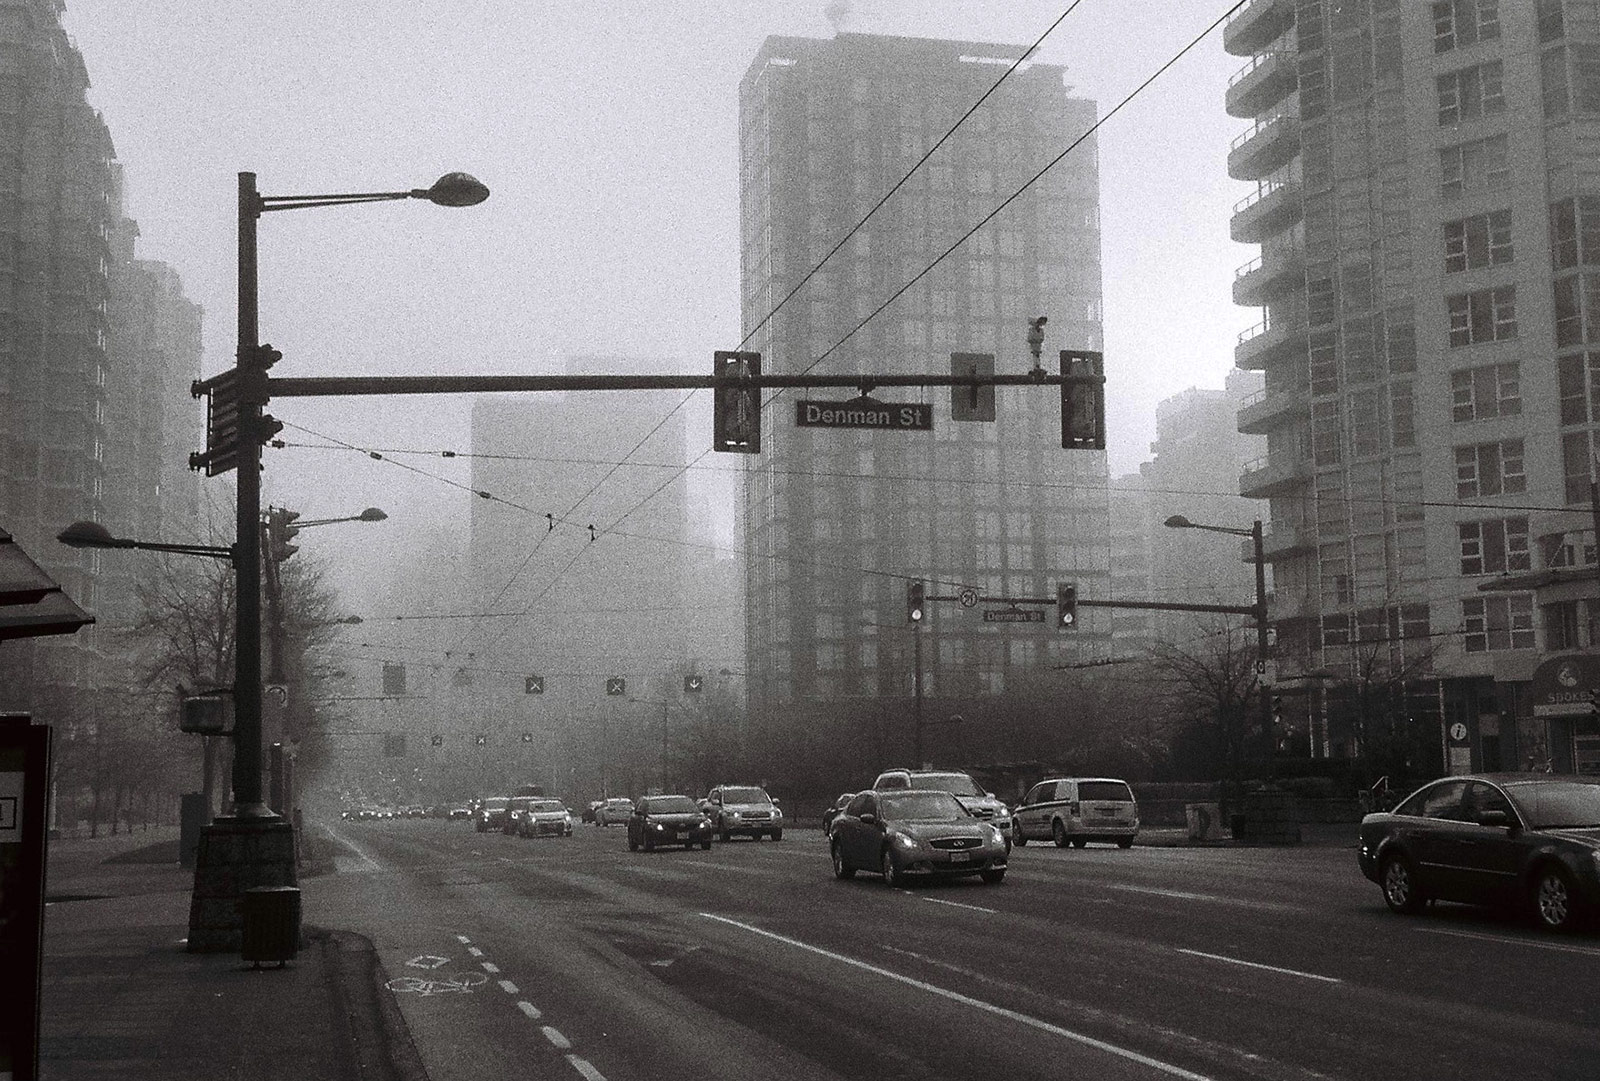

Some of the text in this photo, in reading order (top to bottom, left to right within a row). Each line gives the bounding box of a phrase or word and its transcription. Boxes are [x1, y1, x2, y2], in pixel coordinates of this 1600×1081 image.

[806, 404, 922, 425] Denman St
[987, 612, 1041, 621] Denman St
